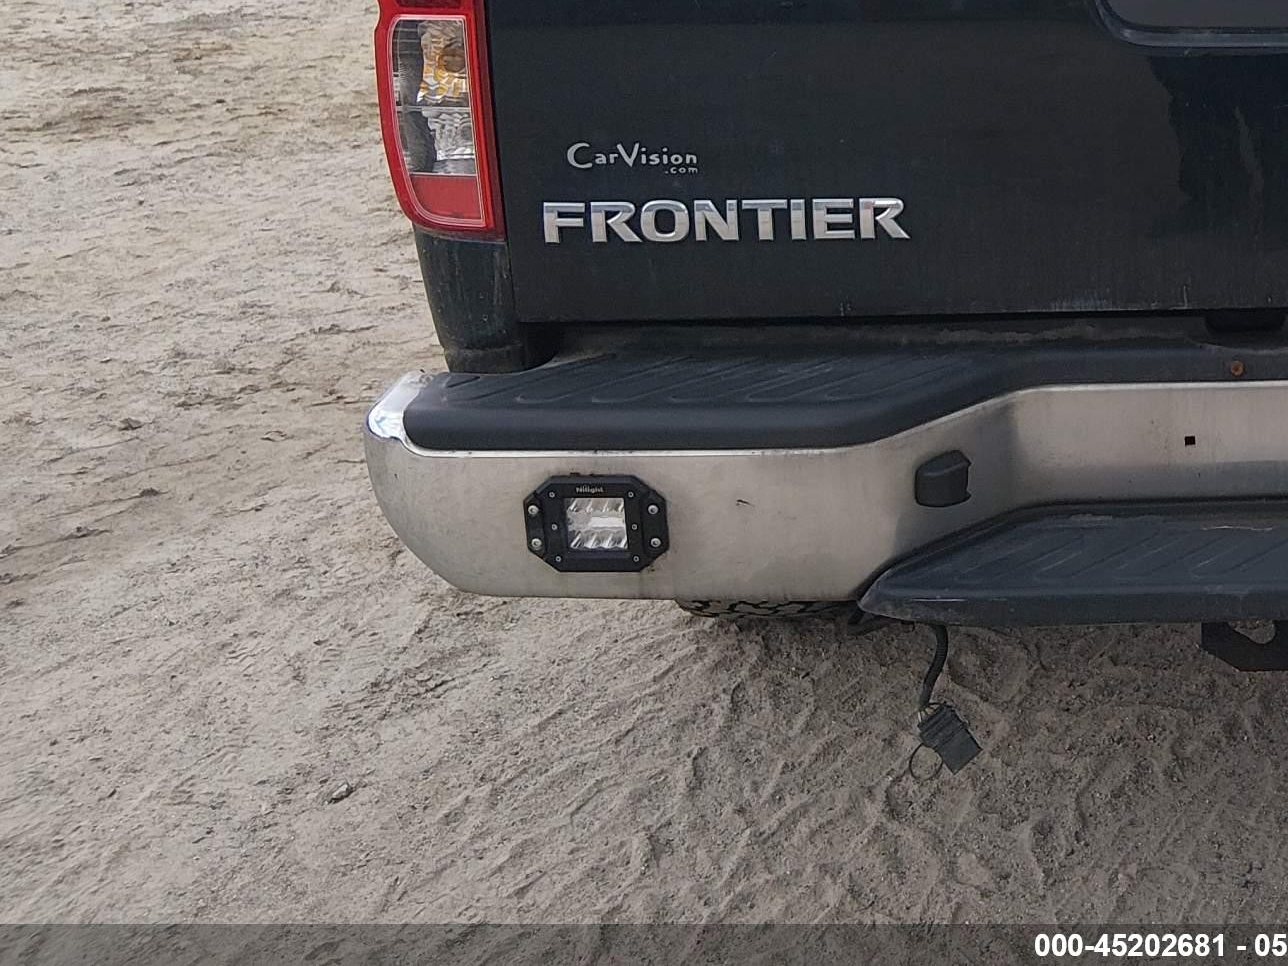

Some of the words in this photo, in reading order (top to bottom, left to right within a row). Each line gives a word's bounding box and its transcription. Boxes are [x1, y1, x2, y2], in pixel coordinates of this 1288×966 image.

[566, 142, 698, 169] CarVision
[663, 165, 699, 175] .com
[543, 197, 911, 244] FRONTIER
